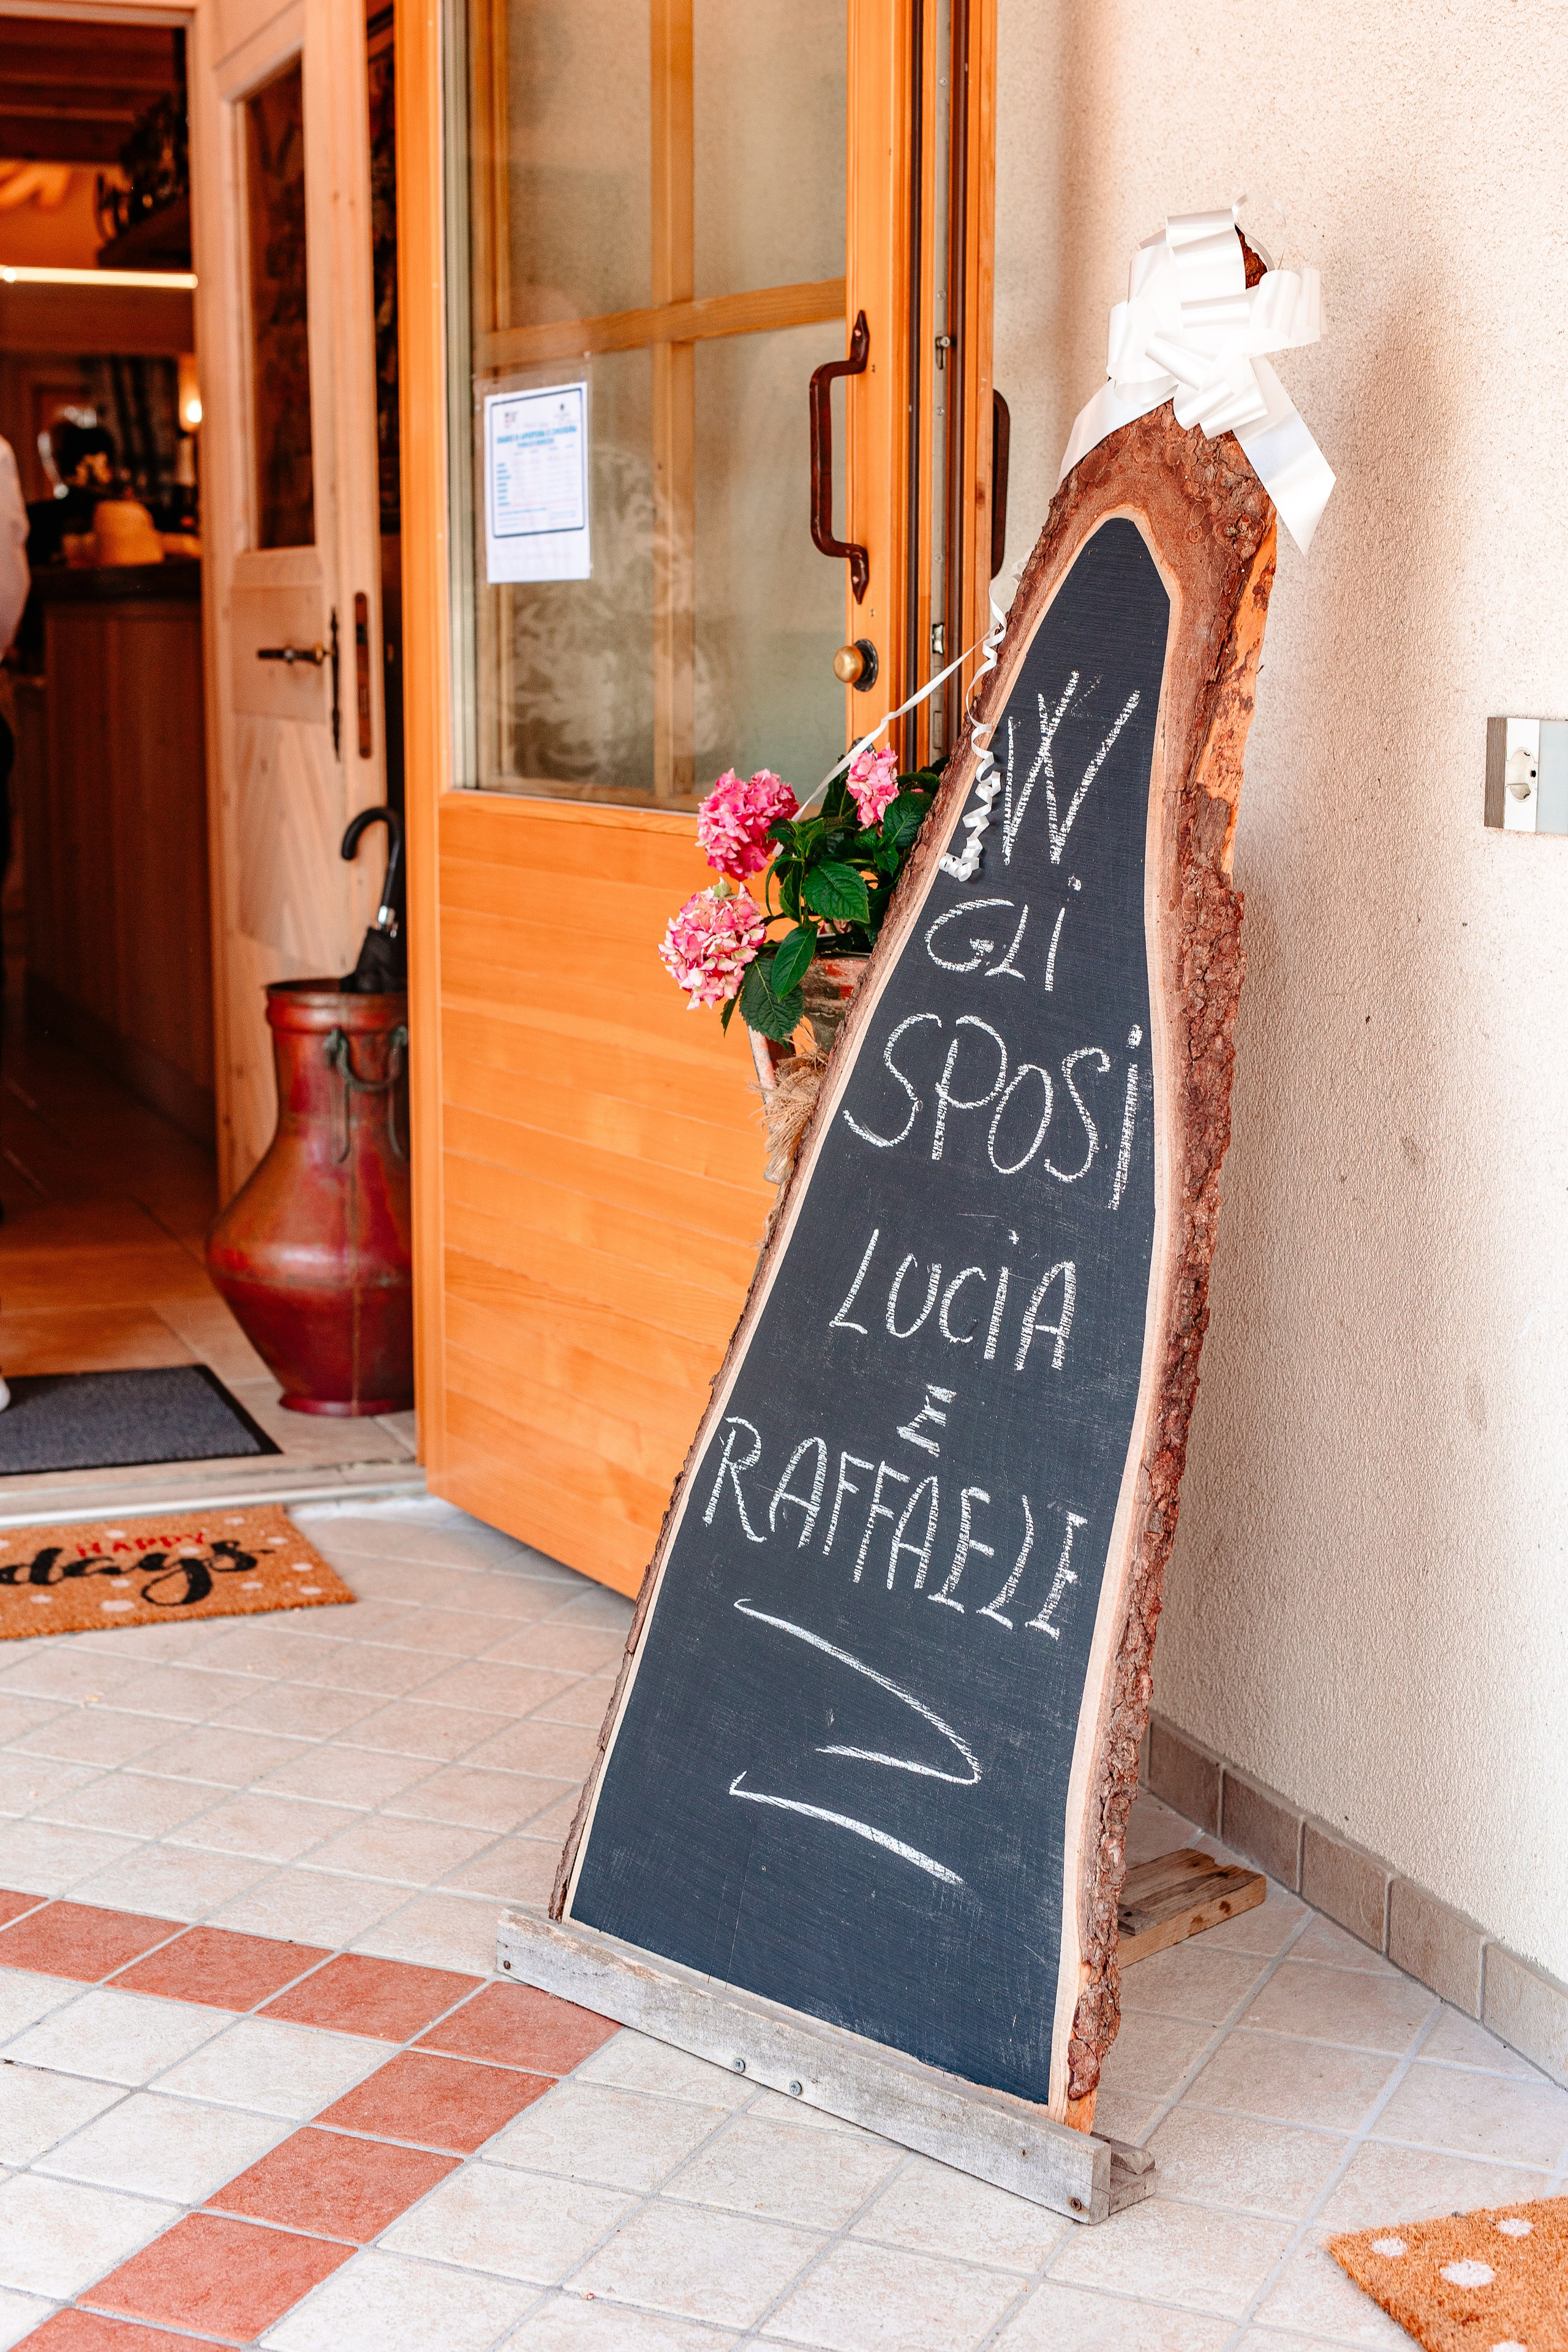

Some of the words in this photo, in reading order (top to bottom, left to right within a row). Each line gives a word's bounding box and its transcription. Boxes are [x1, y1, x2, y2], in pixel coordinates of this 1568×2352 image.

[896, 1382, 957, 1457] E
[75, 1531, 205, 1558] HAPPY
[702, 1415, 1088, 1642] RAFFAELE
